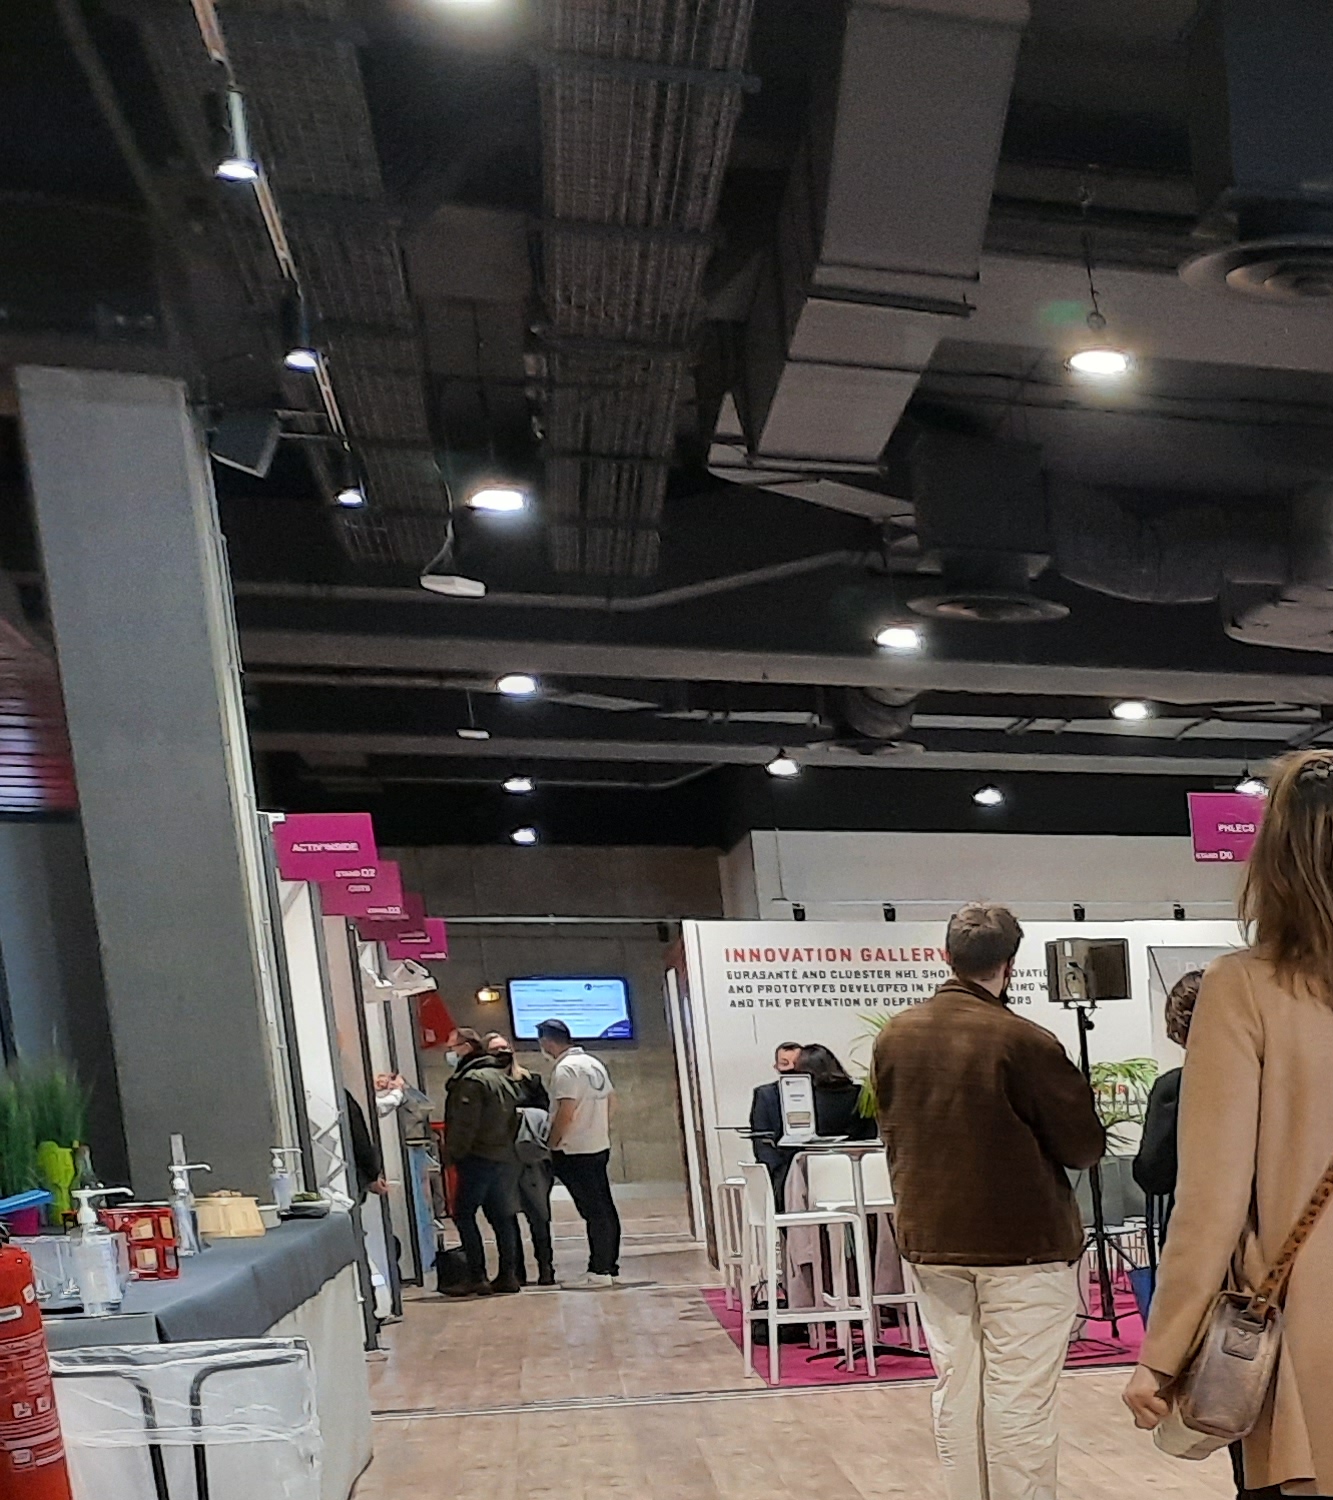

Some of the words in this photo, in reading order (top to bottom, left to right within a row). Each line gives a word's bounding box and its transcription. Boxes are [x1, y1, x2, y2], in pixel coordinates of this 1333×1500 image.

[725, 948, 851, 962] INNOVATION
[802, 970, 827, 979] AND
[830, 970, 891, 979] CLUBSTER
[728, 985, 753, 994] AND
[757, 984, 835, 993] PROTOTYPES
[840, 984, 908, 993] DEVELOPED
[912, 983, 923, 992] IN
[730, 999, 753, 1008] AND
[758, 999, 780, 1008] THE
[785, 998, 860, 1007] PREVENTION
[865, 998, 878, 1007] OF
